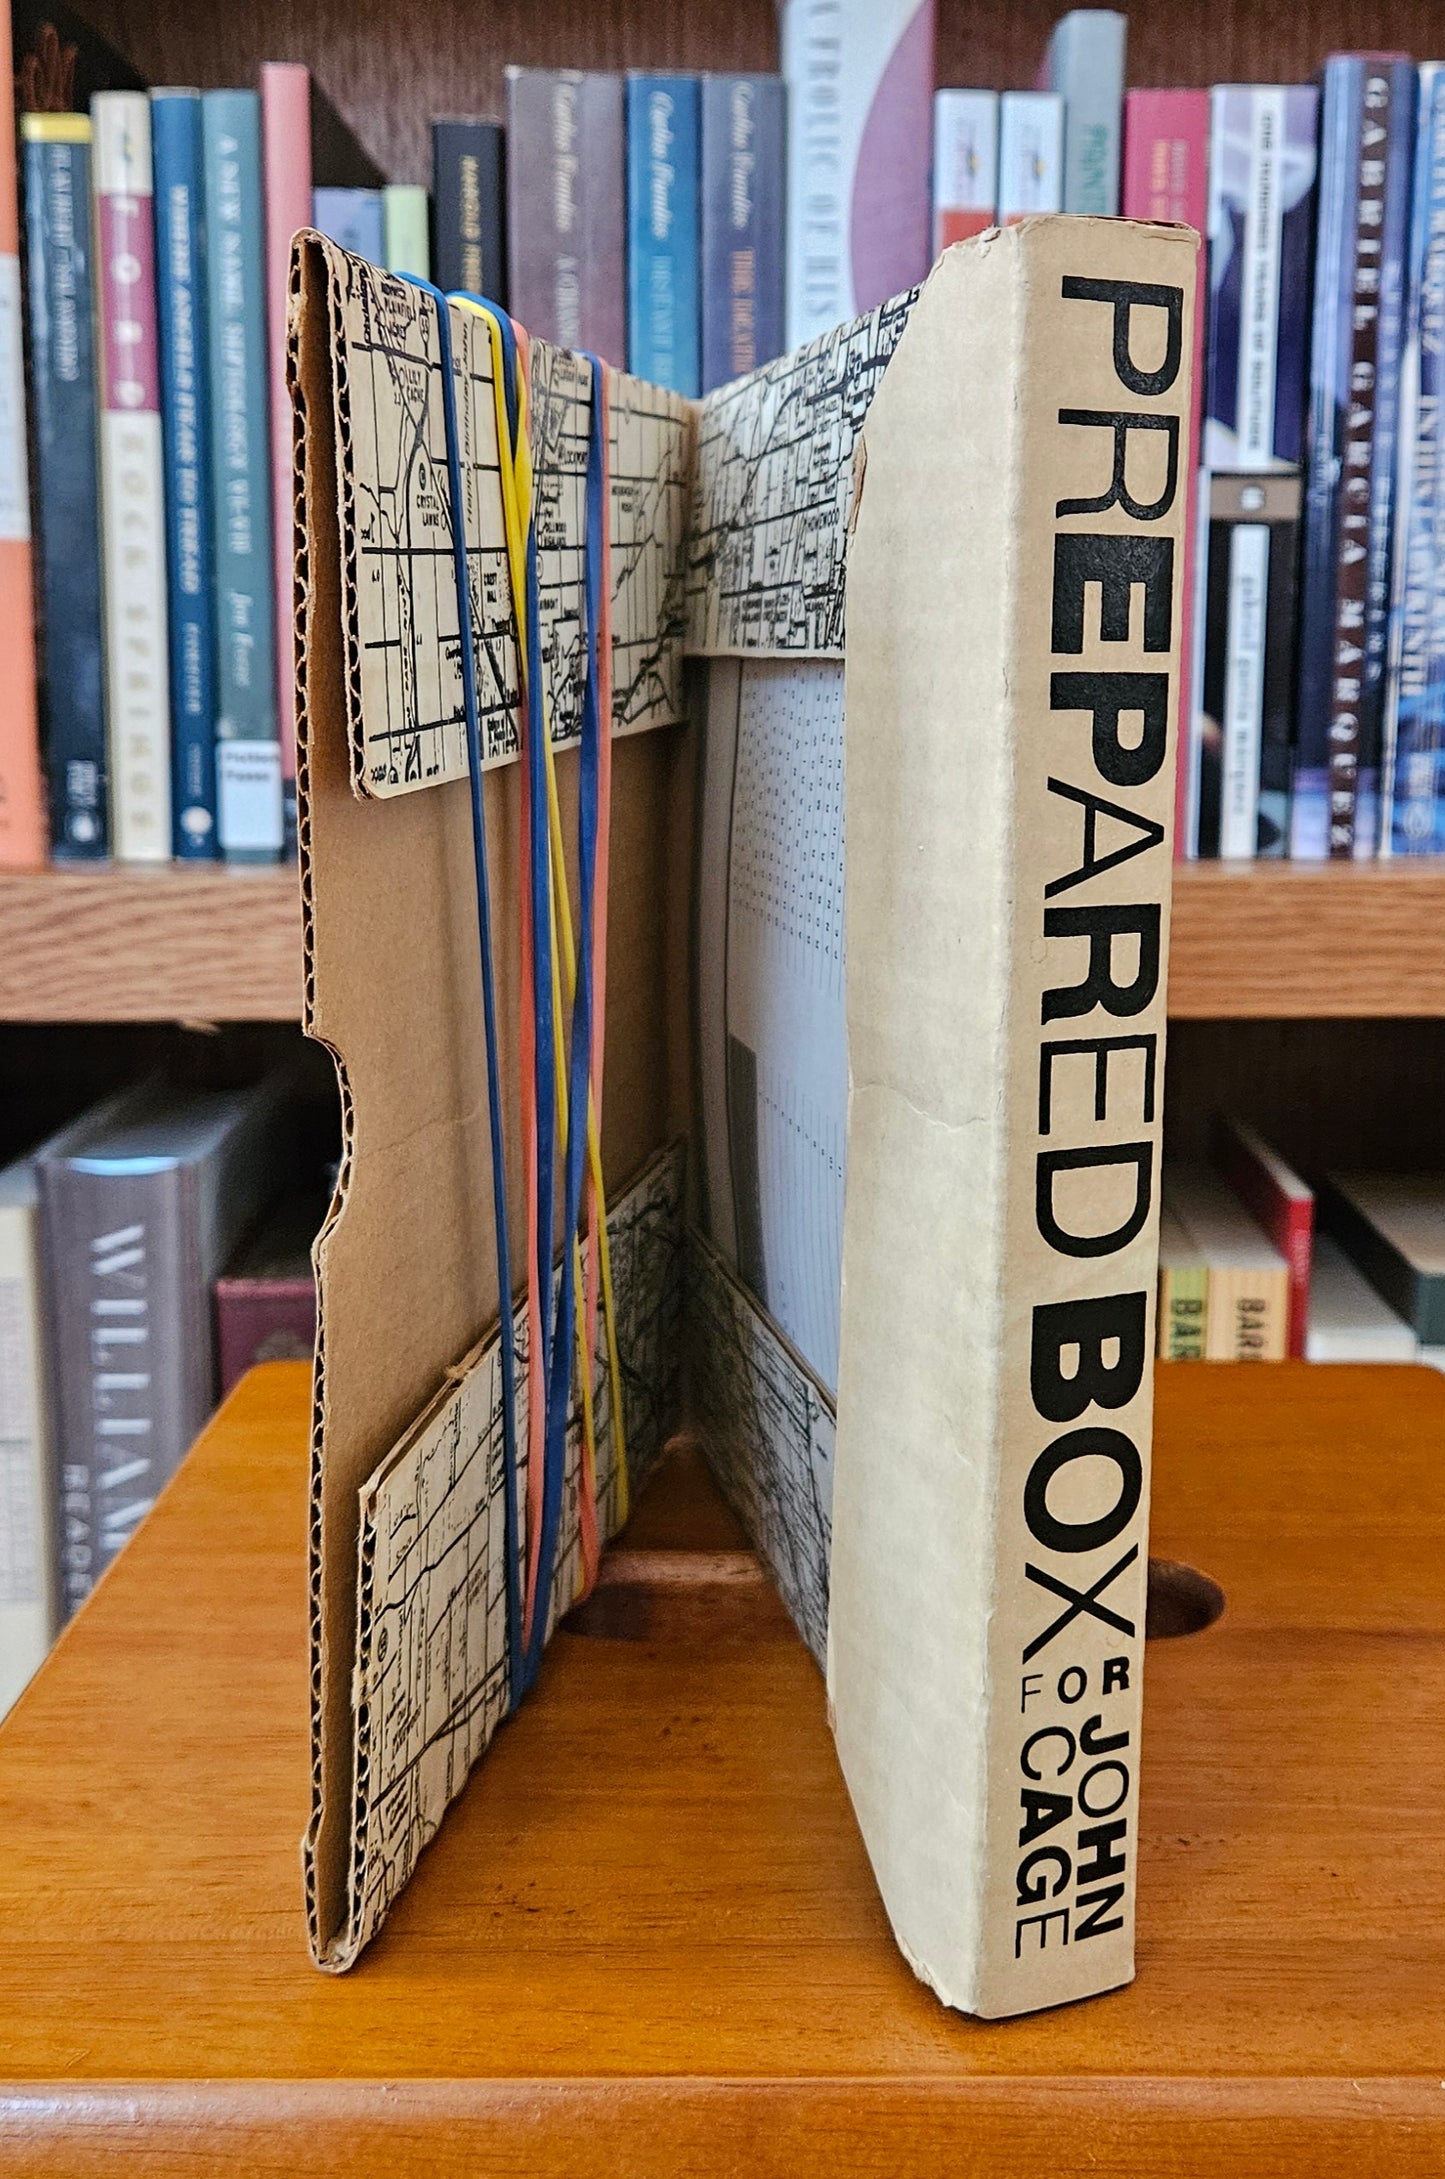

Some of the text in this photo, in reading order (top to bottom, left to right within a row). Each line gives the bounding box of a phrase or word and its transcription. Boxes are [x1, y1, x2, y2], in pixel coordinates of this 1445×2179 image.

[1352, 75, 1390, 331] GABRIEL
[461, 322, 473, 524] Happy Birthday John
[1023, 276, 1184, 1664] PREPARED BOX
[1021, 1655, 1130, 1714] FOR
[1015, 1726, 1077, 1959] CAGE
[1075, 1714, 1130, 1942] JOHN
